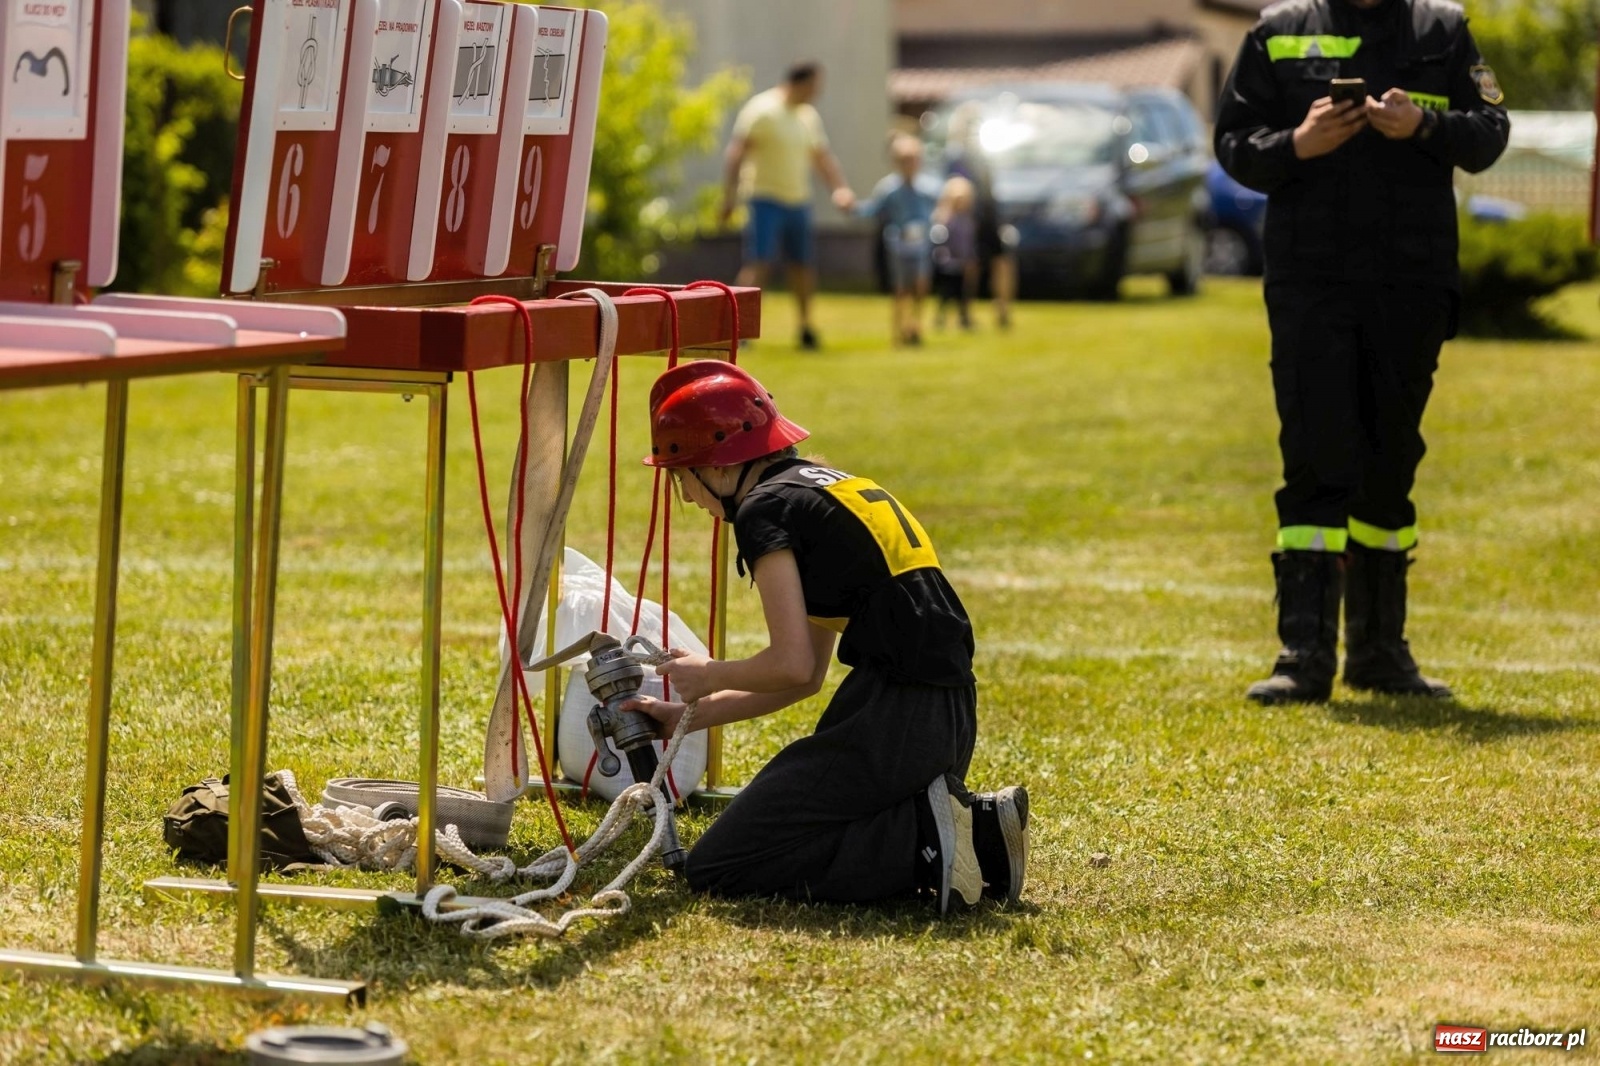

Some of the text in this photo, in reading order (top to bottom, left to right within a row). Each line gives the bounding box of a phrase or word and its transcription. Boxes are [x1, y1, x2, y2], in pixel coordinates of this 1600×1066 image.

[18, 154, 49, 262] 5
[277, 143, 304, 239] 6
[367, 144, 392, 234] 7
[445, 145, 471, 233] 8
[520, 145, 543, 230] 9
[857, 489, 922, 549] 7
